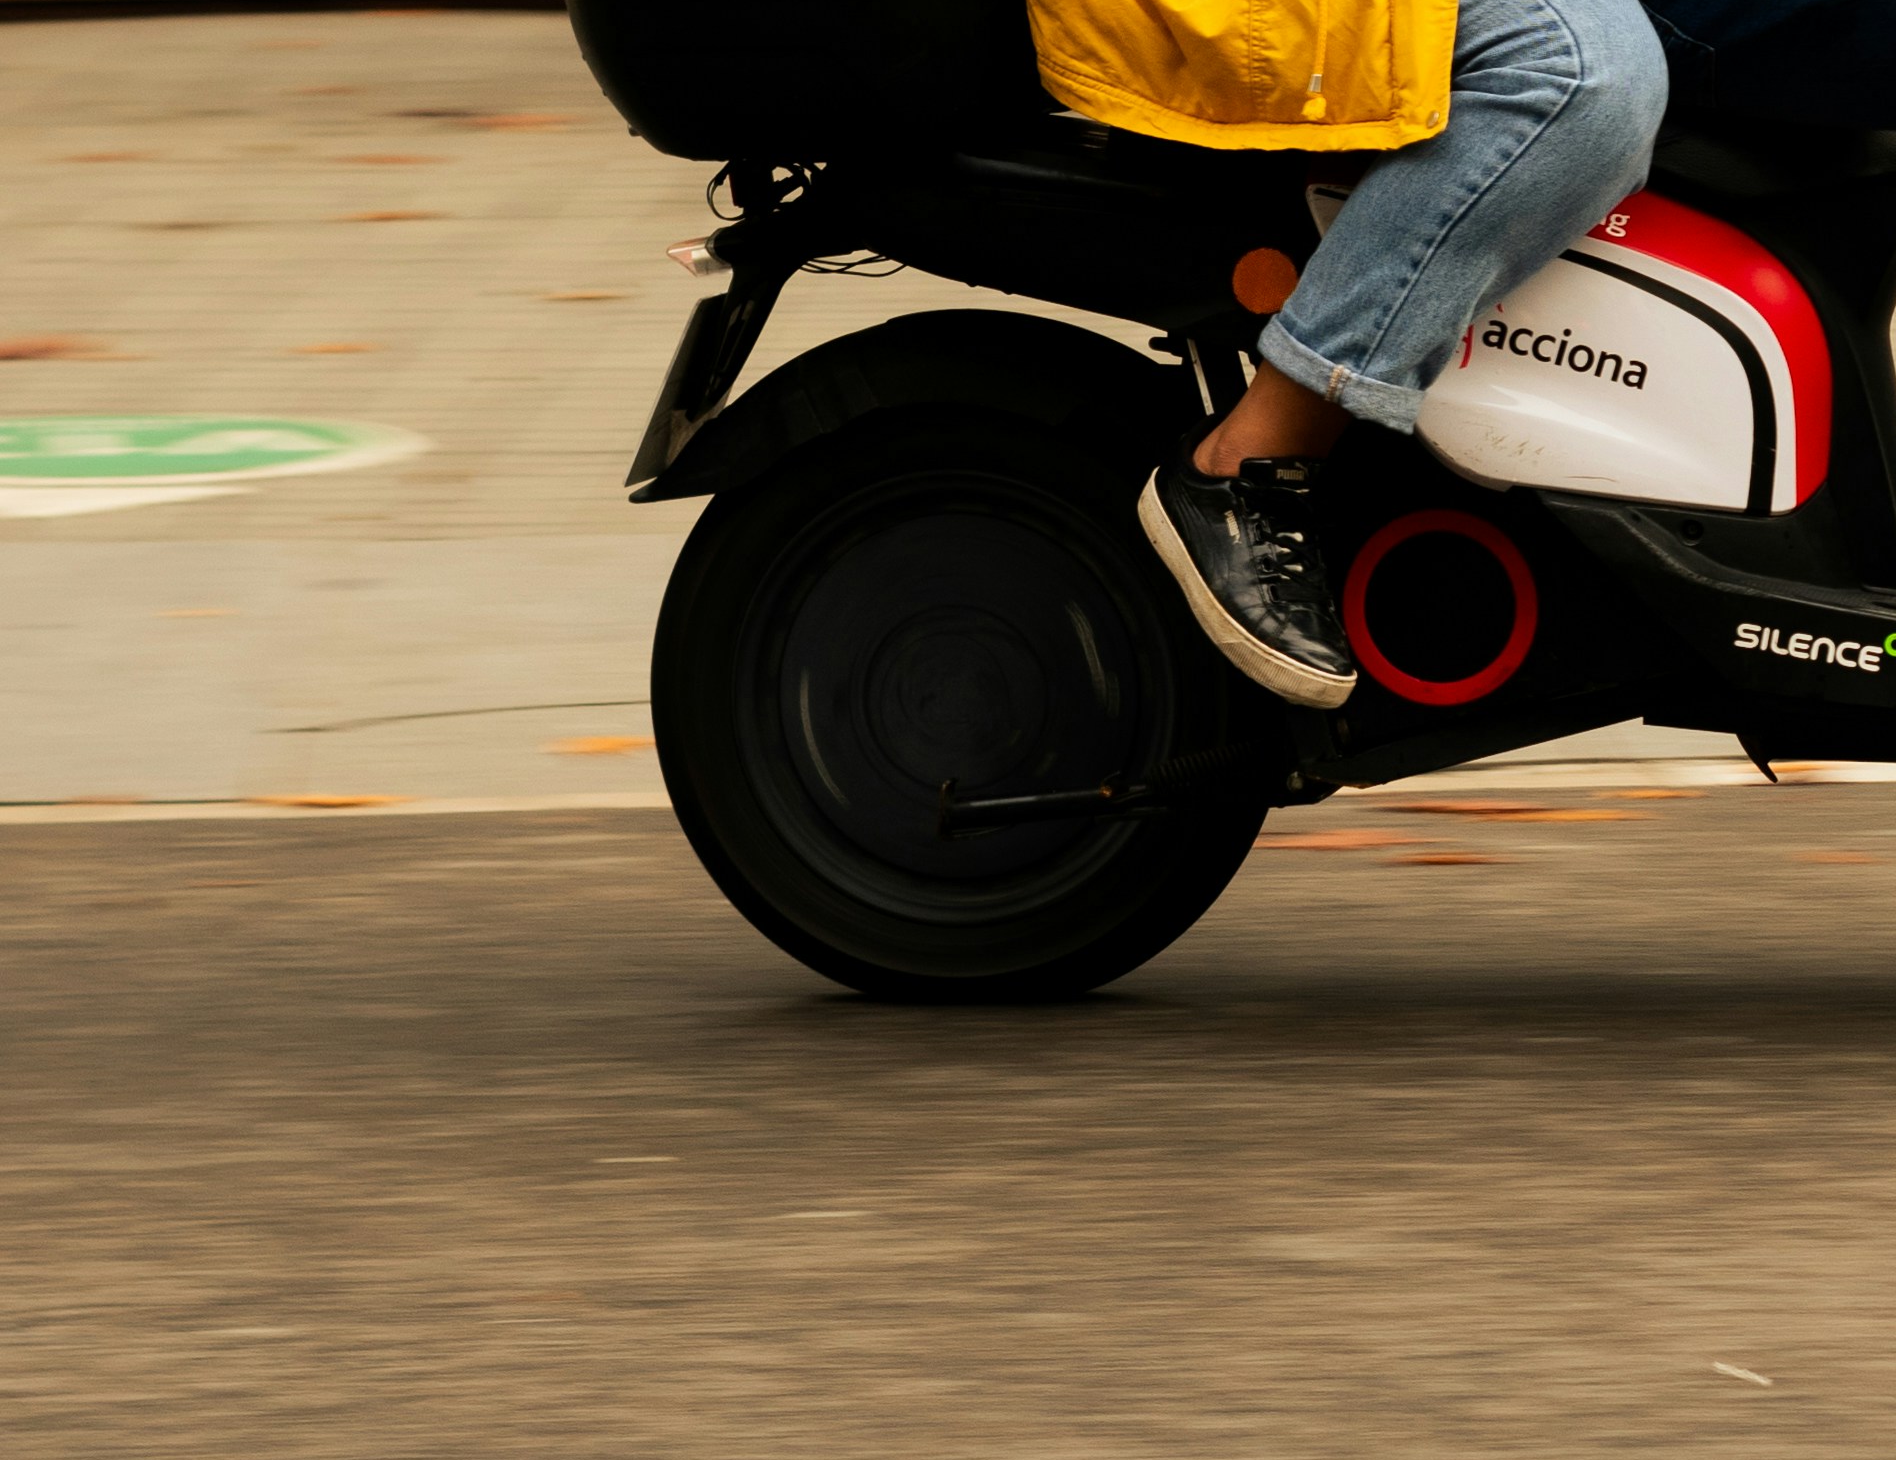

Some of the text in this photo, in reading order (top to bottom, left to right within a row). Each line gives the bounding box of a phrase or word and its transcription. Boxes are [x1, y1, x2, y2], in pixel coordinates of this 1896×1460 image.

[1482, 319, 1648, 390] acciona
[1276, 468, 1305, 481] PUMA
[1733, 623, 1884, 672] SILENCE
